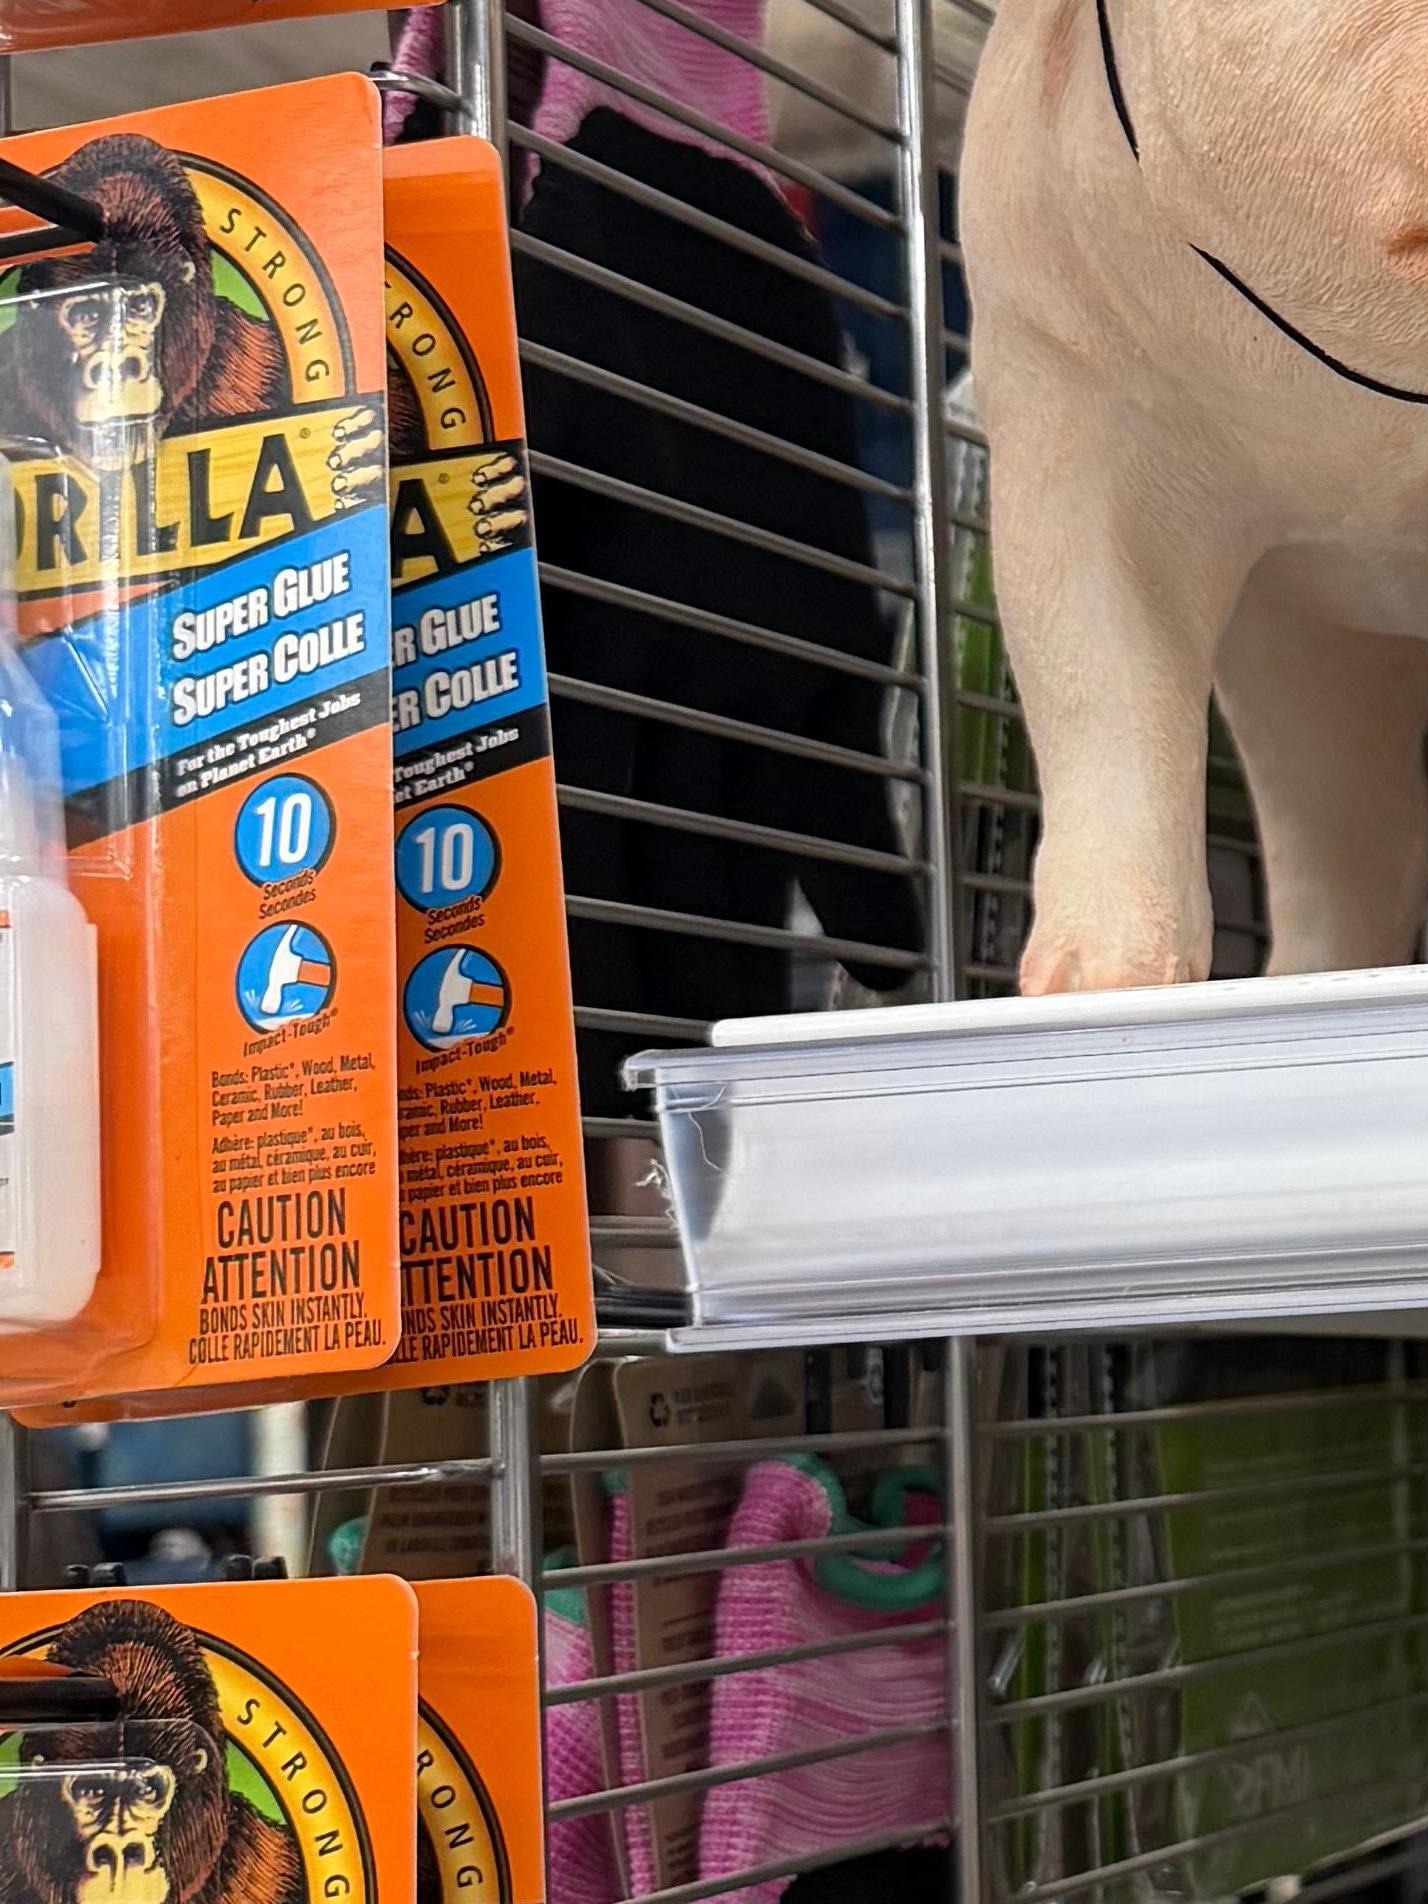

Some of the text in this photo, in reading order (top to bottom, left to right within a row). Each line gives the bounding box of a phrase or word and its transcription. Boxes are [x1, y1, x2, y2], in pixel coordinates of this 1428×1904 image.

[220, 207, 331, 384] STRONG
[172, 552, 350, 661] SUPER GLUE
[420, 594, 500, 657] GLUE
[172, 614, 365, 726] SUPER COLLE
[424, 652, 520, 719] COLLE
[256, 792, 312, 866] 10
[416, 823, 474, 893] 10
[217, 1187, 346, 1249] CAUTION
[401, 1196, 536, 1256] CAUTION
[201, 1239, 360, 1305] ATTENTION
[200, 1292, 367, 1335] BONDS SKIN INSTANTLY.
[233, 1319, 387, 1360] RAPIDEMENT LA PEAU.
[237, 1698, 351, 1900] STRONG
